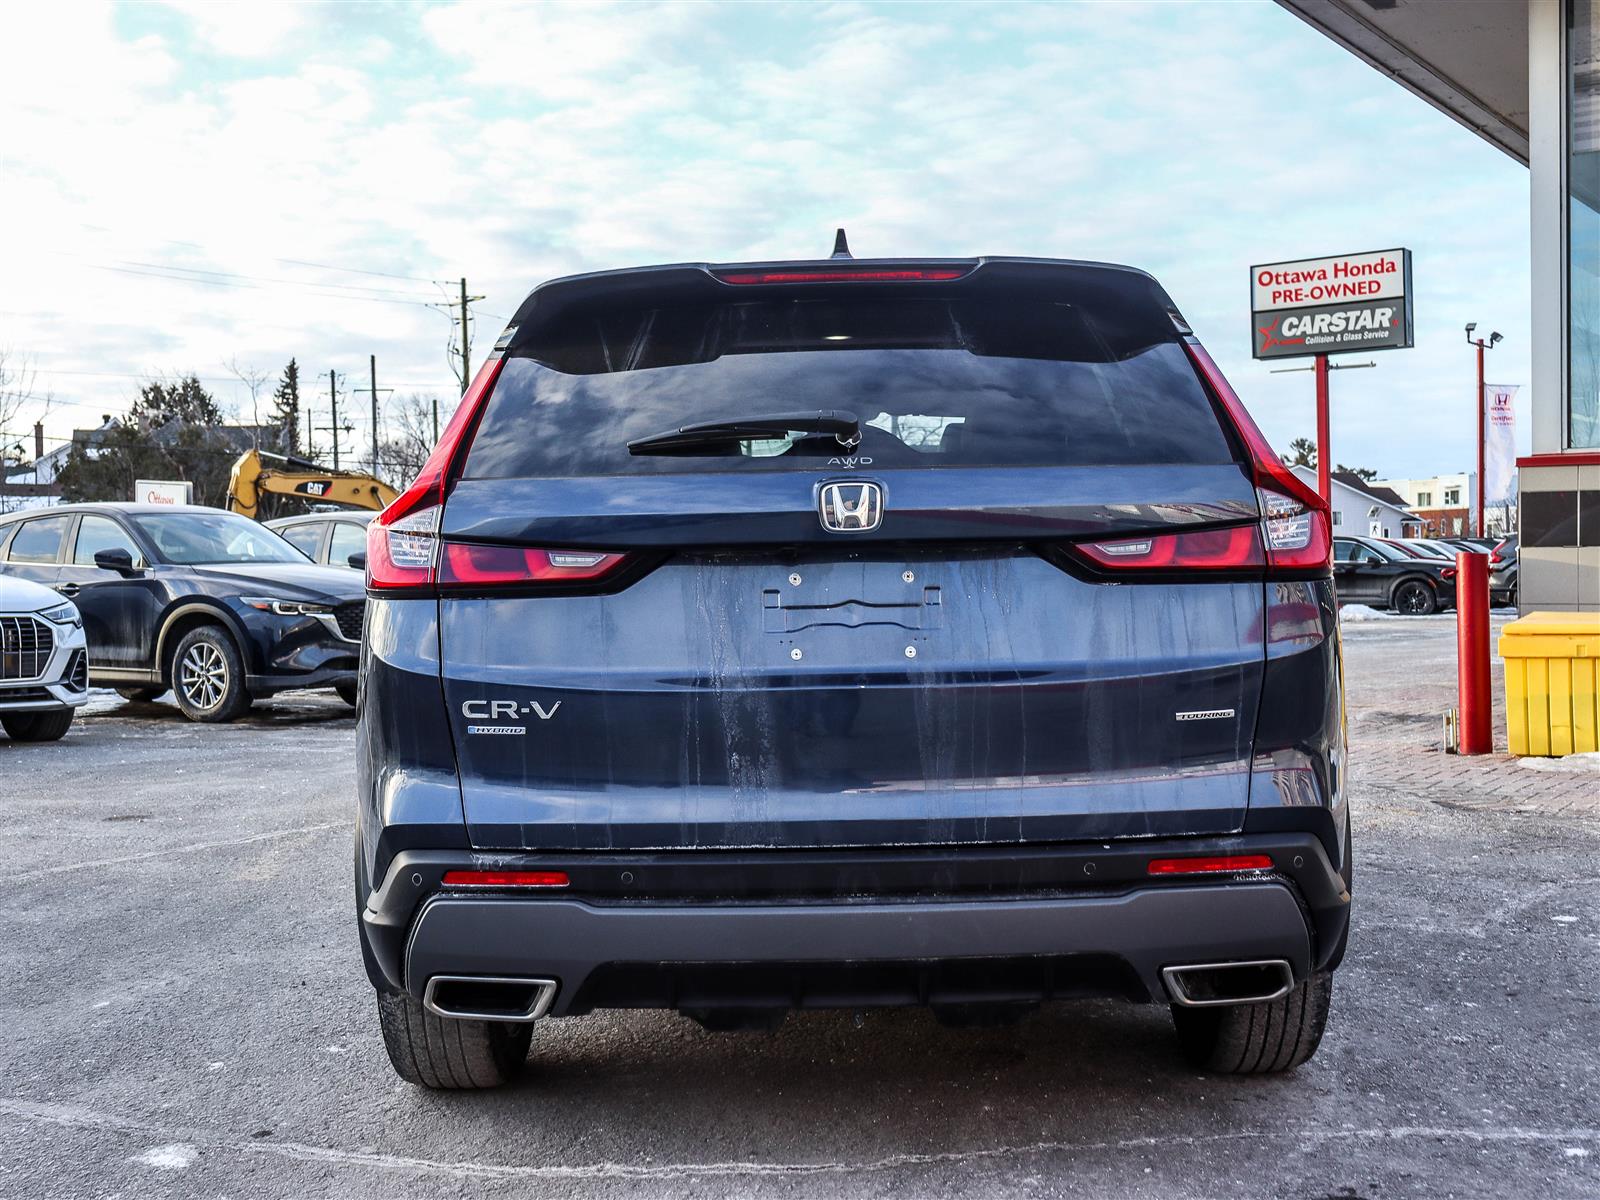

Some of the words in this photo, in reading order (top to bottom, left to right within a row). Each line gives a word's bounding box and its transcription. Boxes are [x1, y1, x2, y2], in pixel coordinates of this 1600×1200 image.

[1258, 267, 1328, 287] Ottawa
[1333, 257, 1397, 279] Honda
[1272, 280, 1381, 304] PRE-OWNED
[1281, 307, 1394, 337] CARSTAR
[1305, 335, 1334, 345] Collision
[1335, 334, 1341, 342] &
[1342, 332, 1362, 341] Glass
[1363, 330, 1389, 340] Service
[827, 457, 873, 465] AWD
[307, 481, 324, 496] CAT
[461, 700, 562, 720] CR-V
[1181, 711, 1232, 720] TOURING
